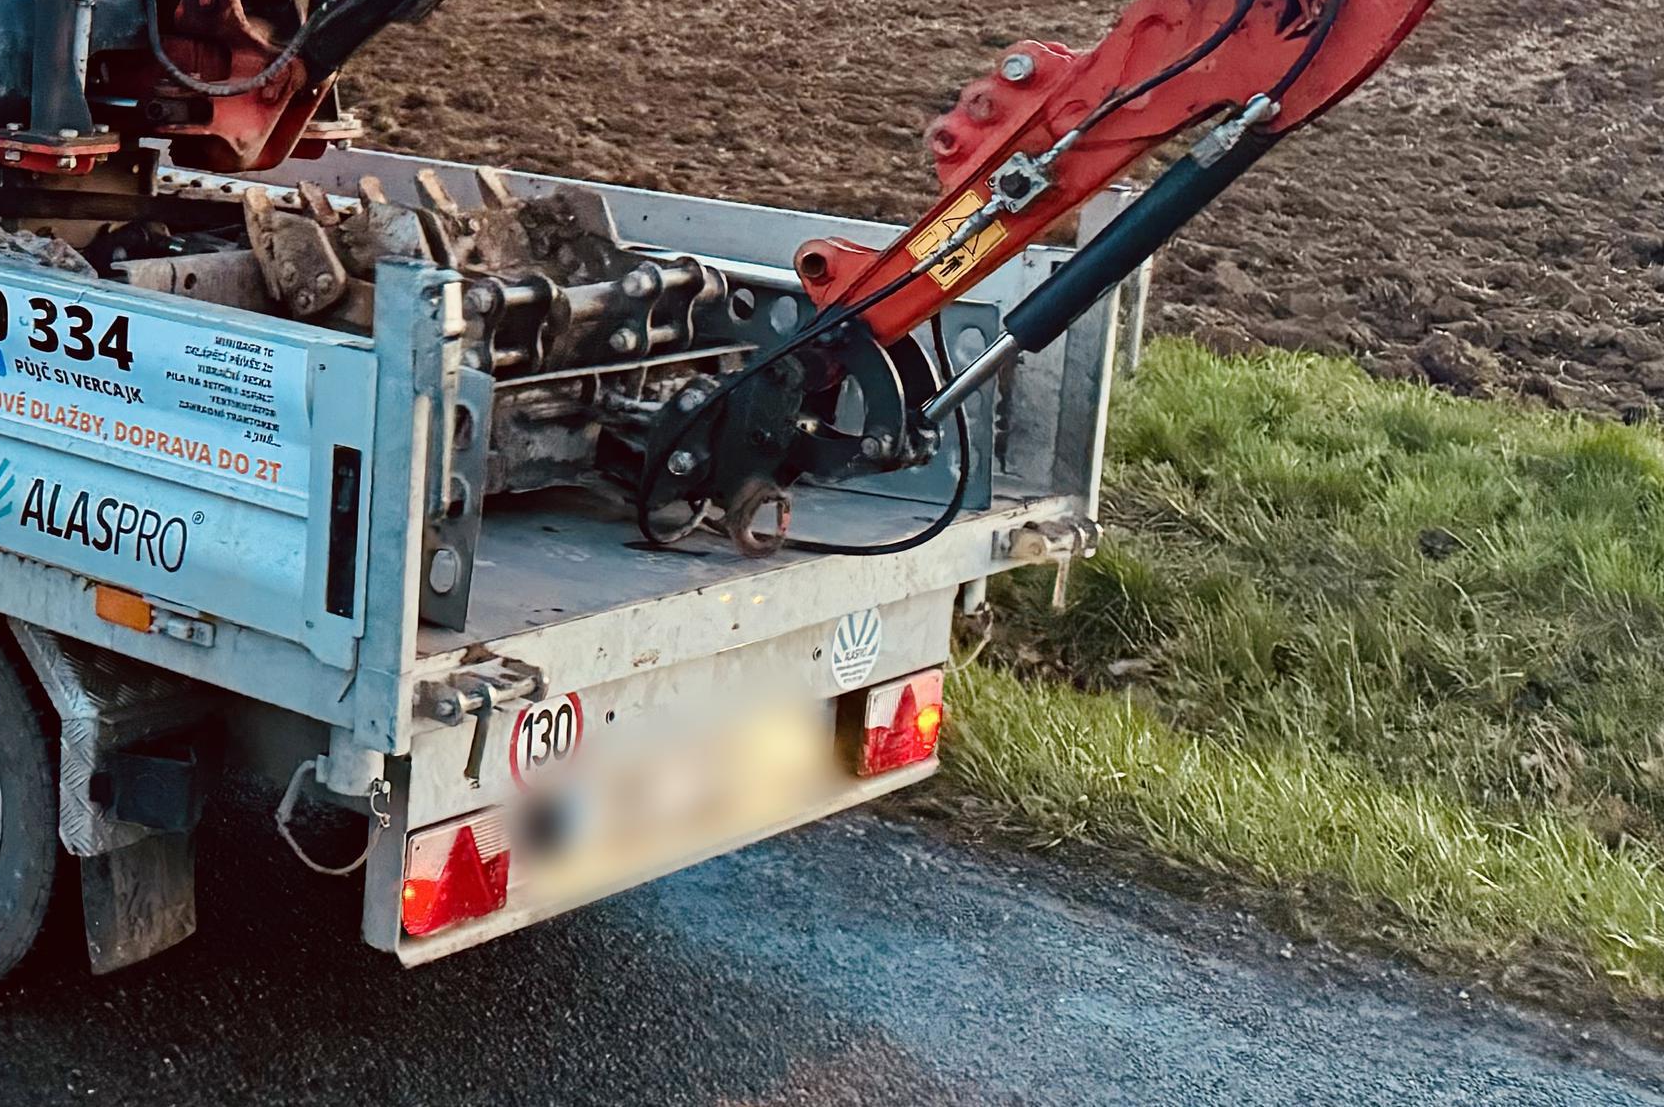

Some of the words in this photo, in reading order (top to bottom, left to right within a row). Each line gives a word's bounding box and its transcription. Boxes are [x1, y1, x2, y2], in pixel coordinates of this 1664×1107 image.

[28, 297, 134, 372] 334
[14, 356, 52, 382] PŮJČ
[55, 368, 69, 385] SI
[71, 373, 144, 404] VERCAJK
[30, 400, 108, 441] DLAŽBY,
[114, 421, 212, 466] DOPRAVA
[218, 448, 249, 475] DO
[255, 458, 282, 483] 2T
[522, 704, 573, 770] 130
